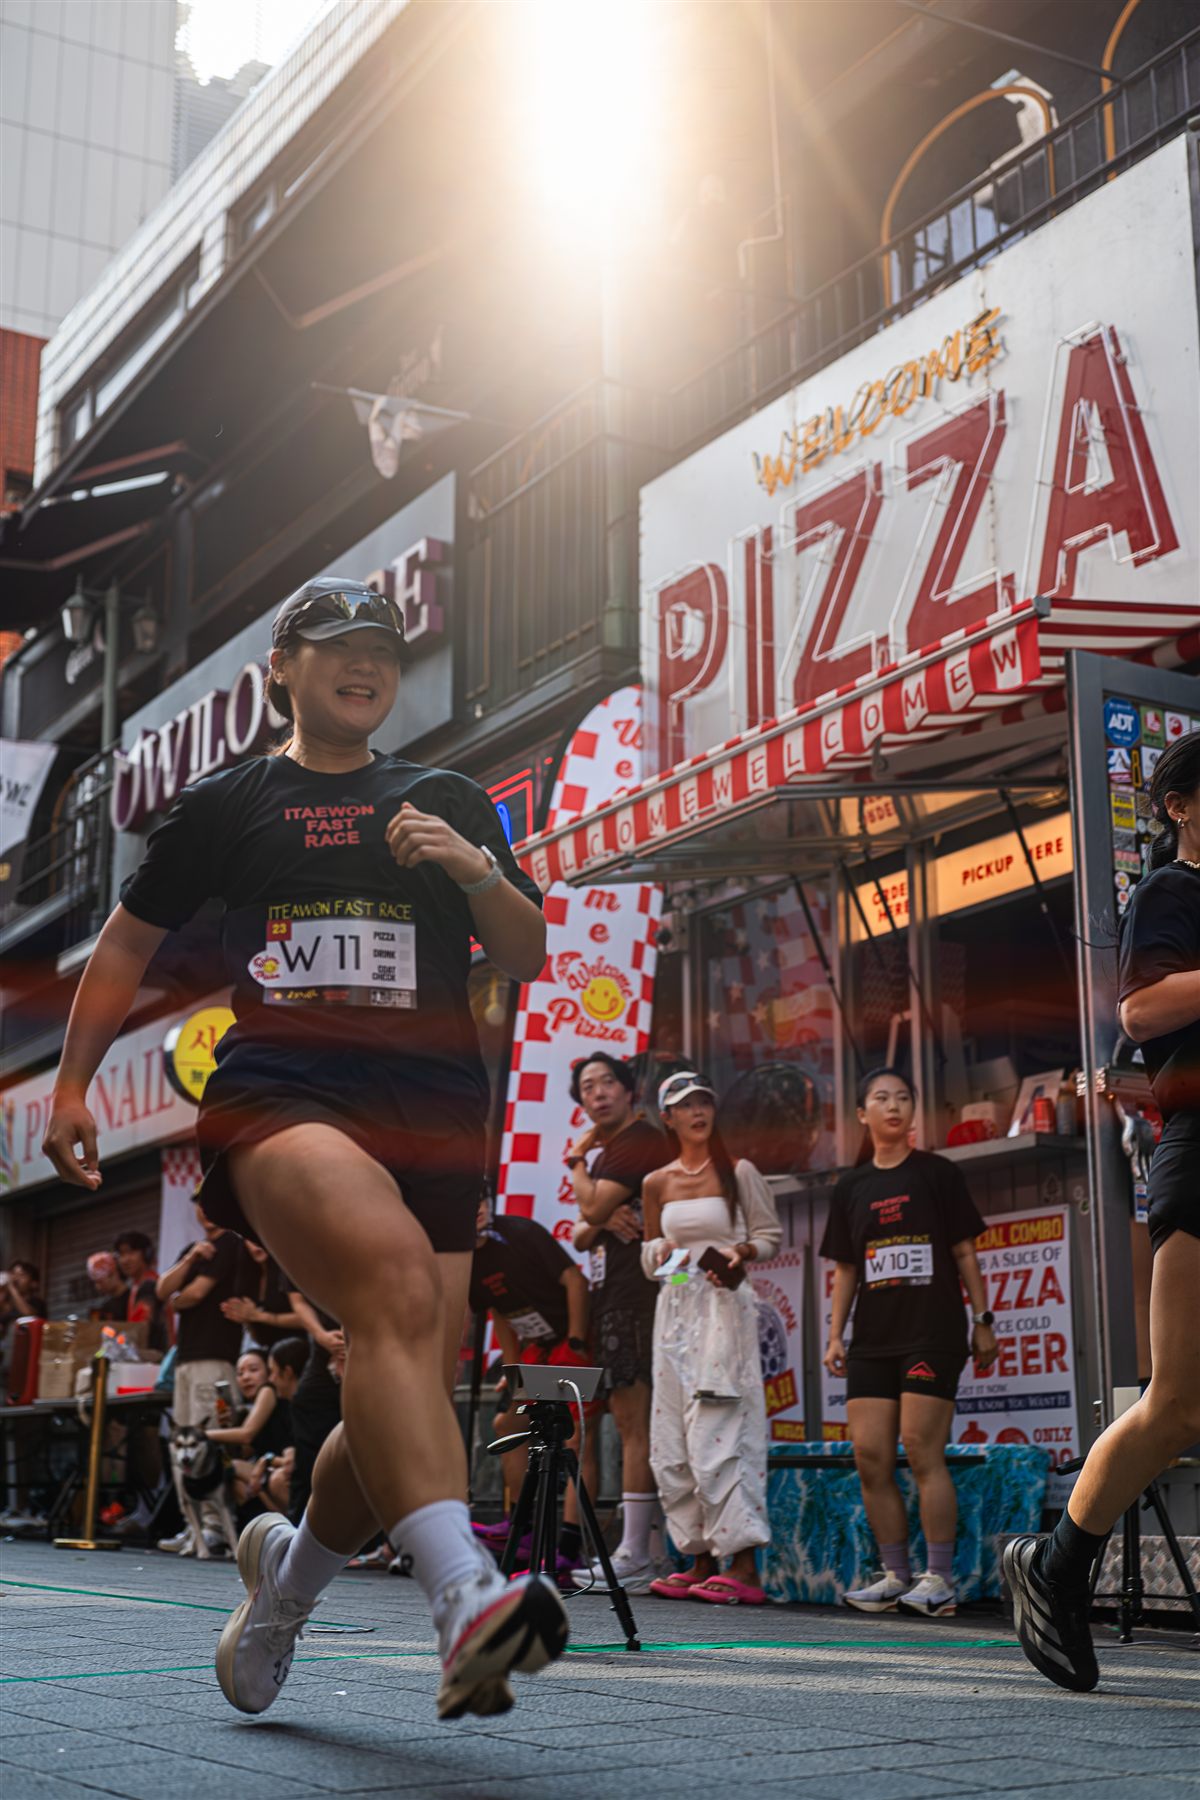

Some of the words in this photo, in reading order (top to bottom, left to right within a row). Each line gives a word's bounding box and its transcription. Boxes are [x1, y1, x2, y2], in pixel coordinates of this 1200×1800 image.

[752, 307, 1003, 496] WELCOME
[646, 320, 1181, 768] PIZZA
[1108, 713, 1134, 732] ADT
[284, 805, 375, 821] ITAEWON
[306, 818, 355, 832] FAST
[304, 831, 360, 848] RACE
[961, 855, 1014, 886] PICKUP
[872, 882, 908, 906] ORDE
[268, 902, 331, 920] ITEAWON
[334, 900, 374, 917] FAST
[379, 902, 413, 920] RACE
[272, 923, 288, 935] 23
[373, 931, 396, 942] PIZZA
[279, 935, 322, 973] W
[333, 934, 361, 970] 11
[372, 949, 396, 960] DRINK
[547, 998, 628, 1043] Pizza
[1009, 1217, 1062, 1244] COMBO
[889, 1252, 909, 1271] 10
[1016, 1315, 1052, 1333] COLD
[1033, 1427, 1074, 1443] ONLY
